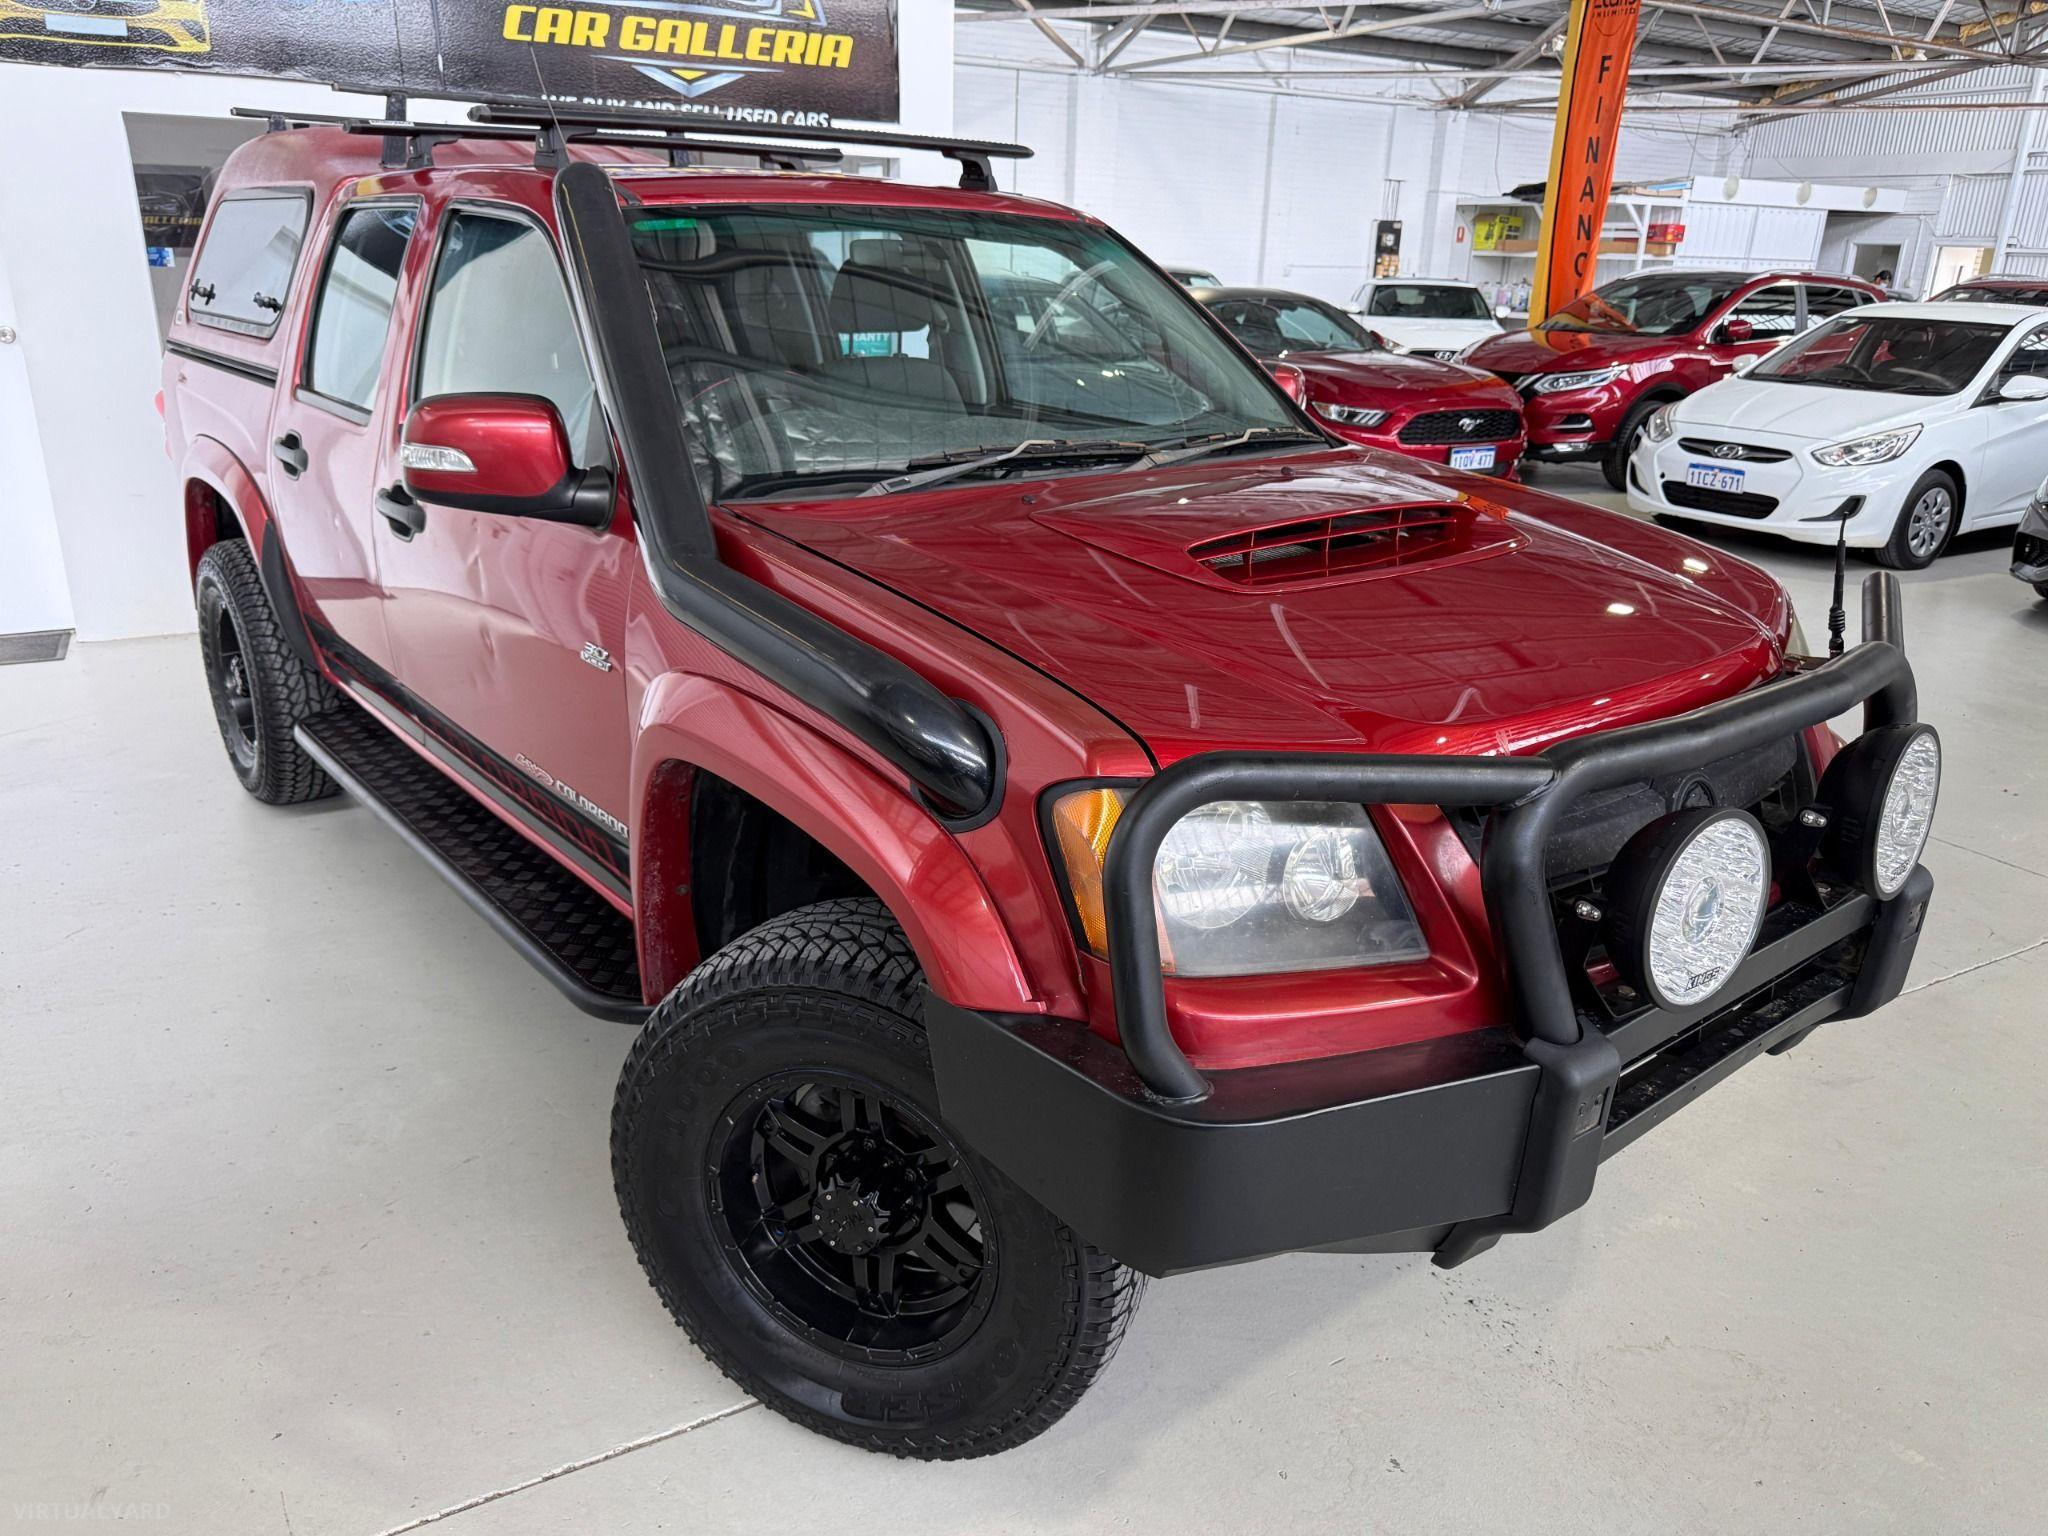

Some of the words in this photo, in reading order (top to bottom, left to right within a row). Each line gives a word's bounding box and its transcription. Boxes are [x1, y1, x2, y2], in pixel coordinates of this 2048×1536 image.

[503, 4, 611, 48] CAR
[619, 15, 854, 69] GALLERIA
[1572, 54, 1613, 300] FINANC
